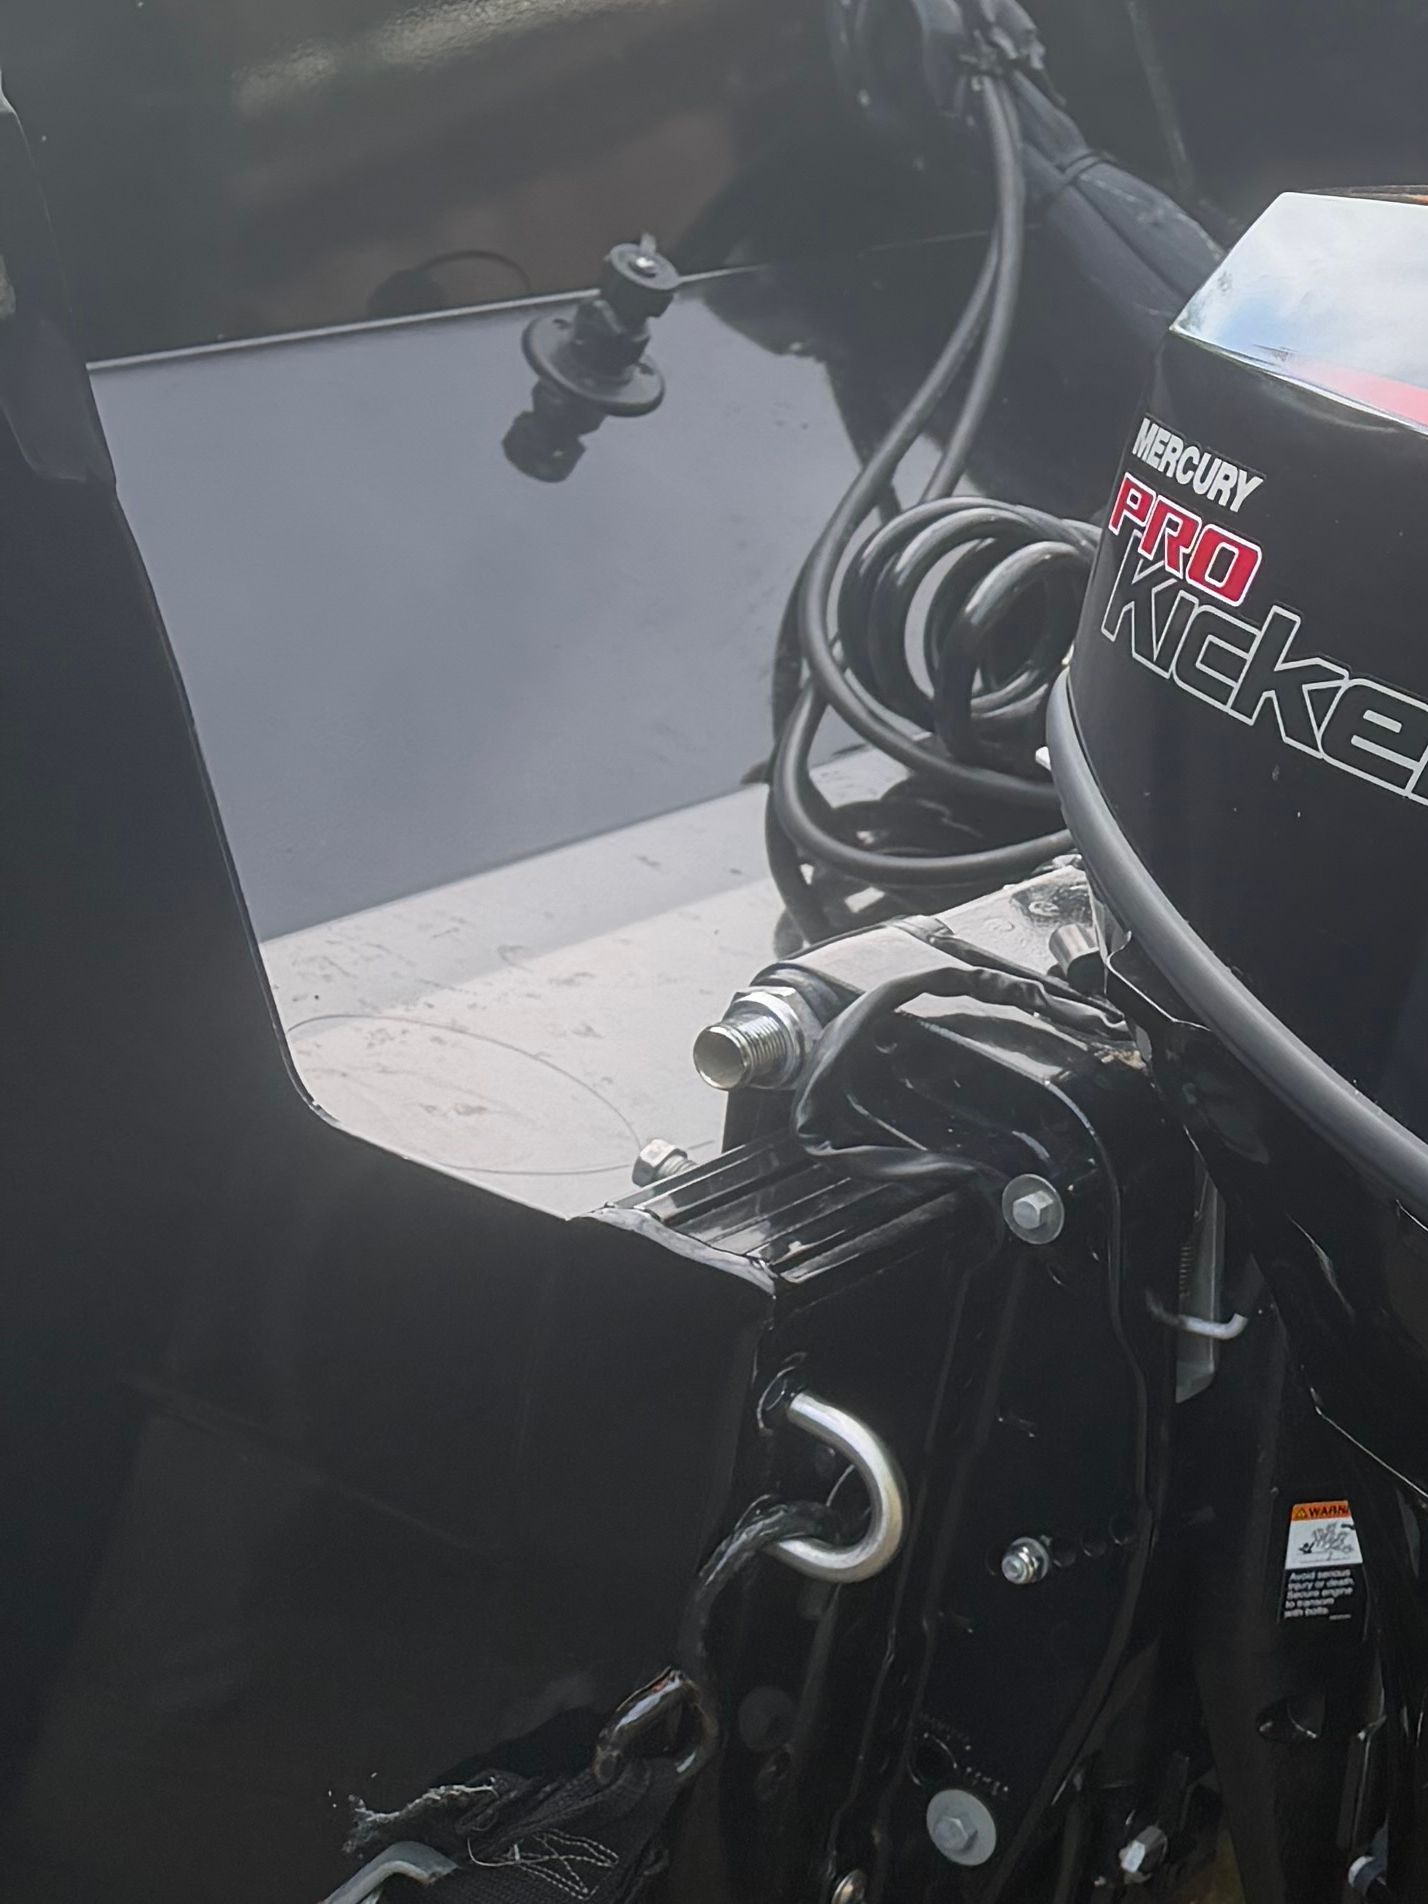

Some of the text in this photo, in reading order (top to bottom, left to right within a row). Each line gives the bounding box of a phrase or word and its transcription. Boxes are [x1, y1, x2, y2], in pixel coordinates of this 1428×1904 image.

[1132, 417, 1264, 513] MERCURY
[1108, 471, 1262, 607] PRO
[1289, 1571, 1316, 1581] Avoid
